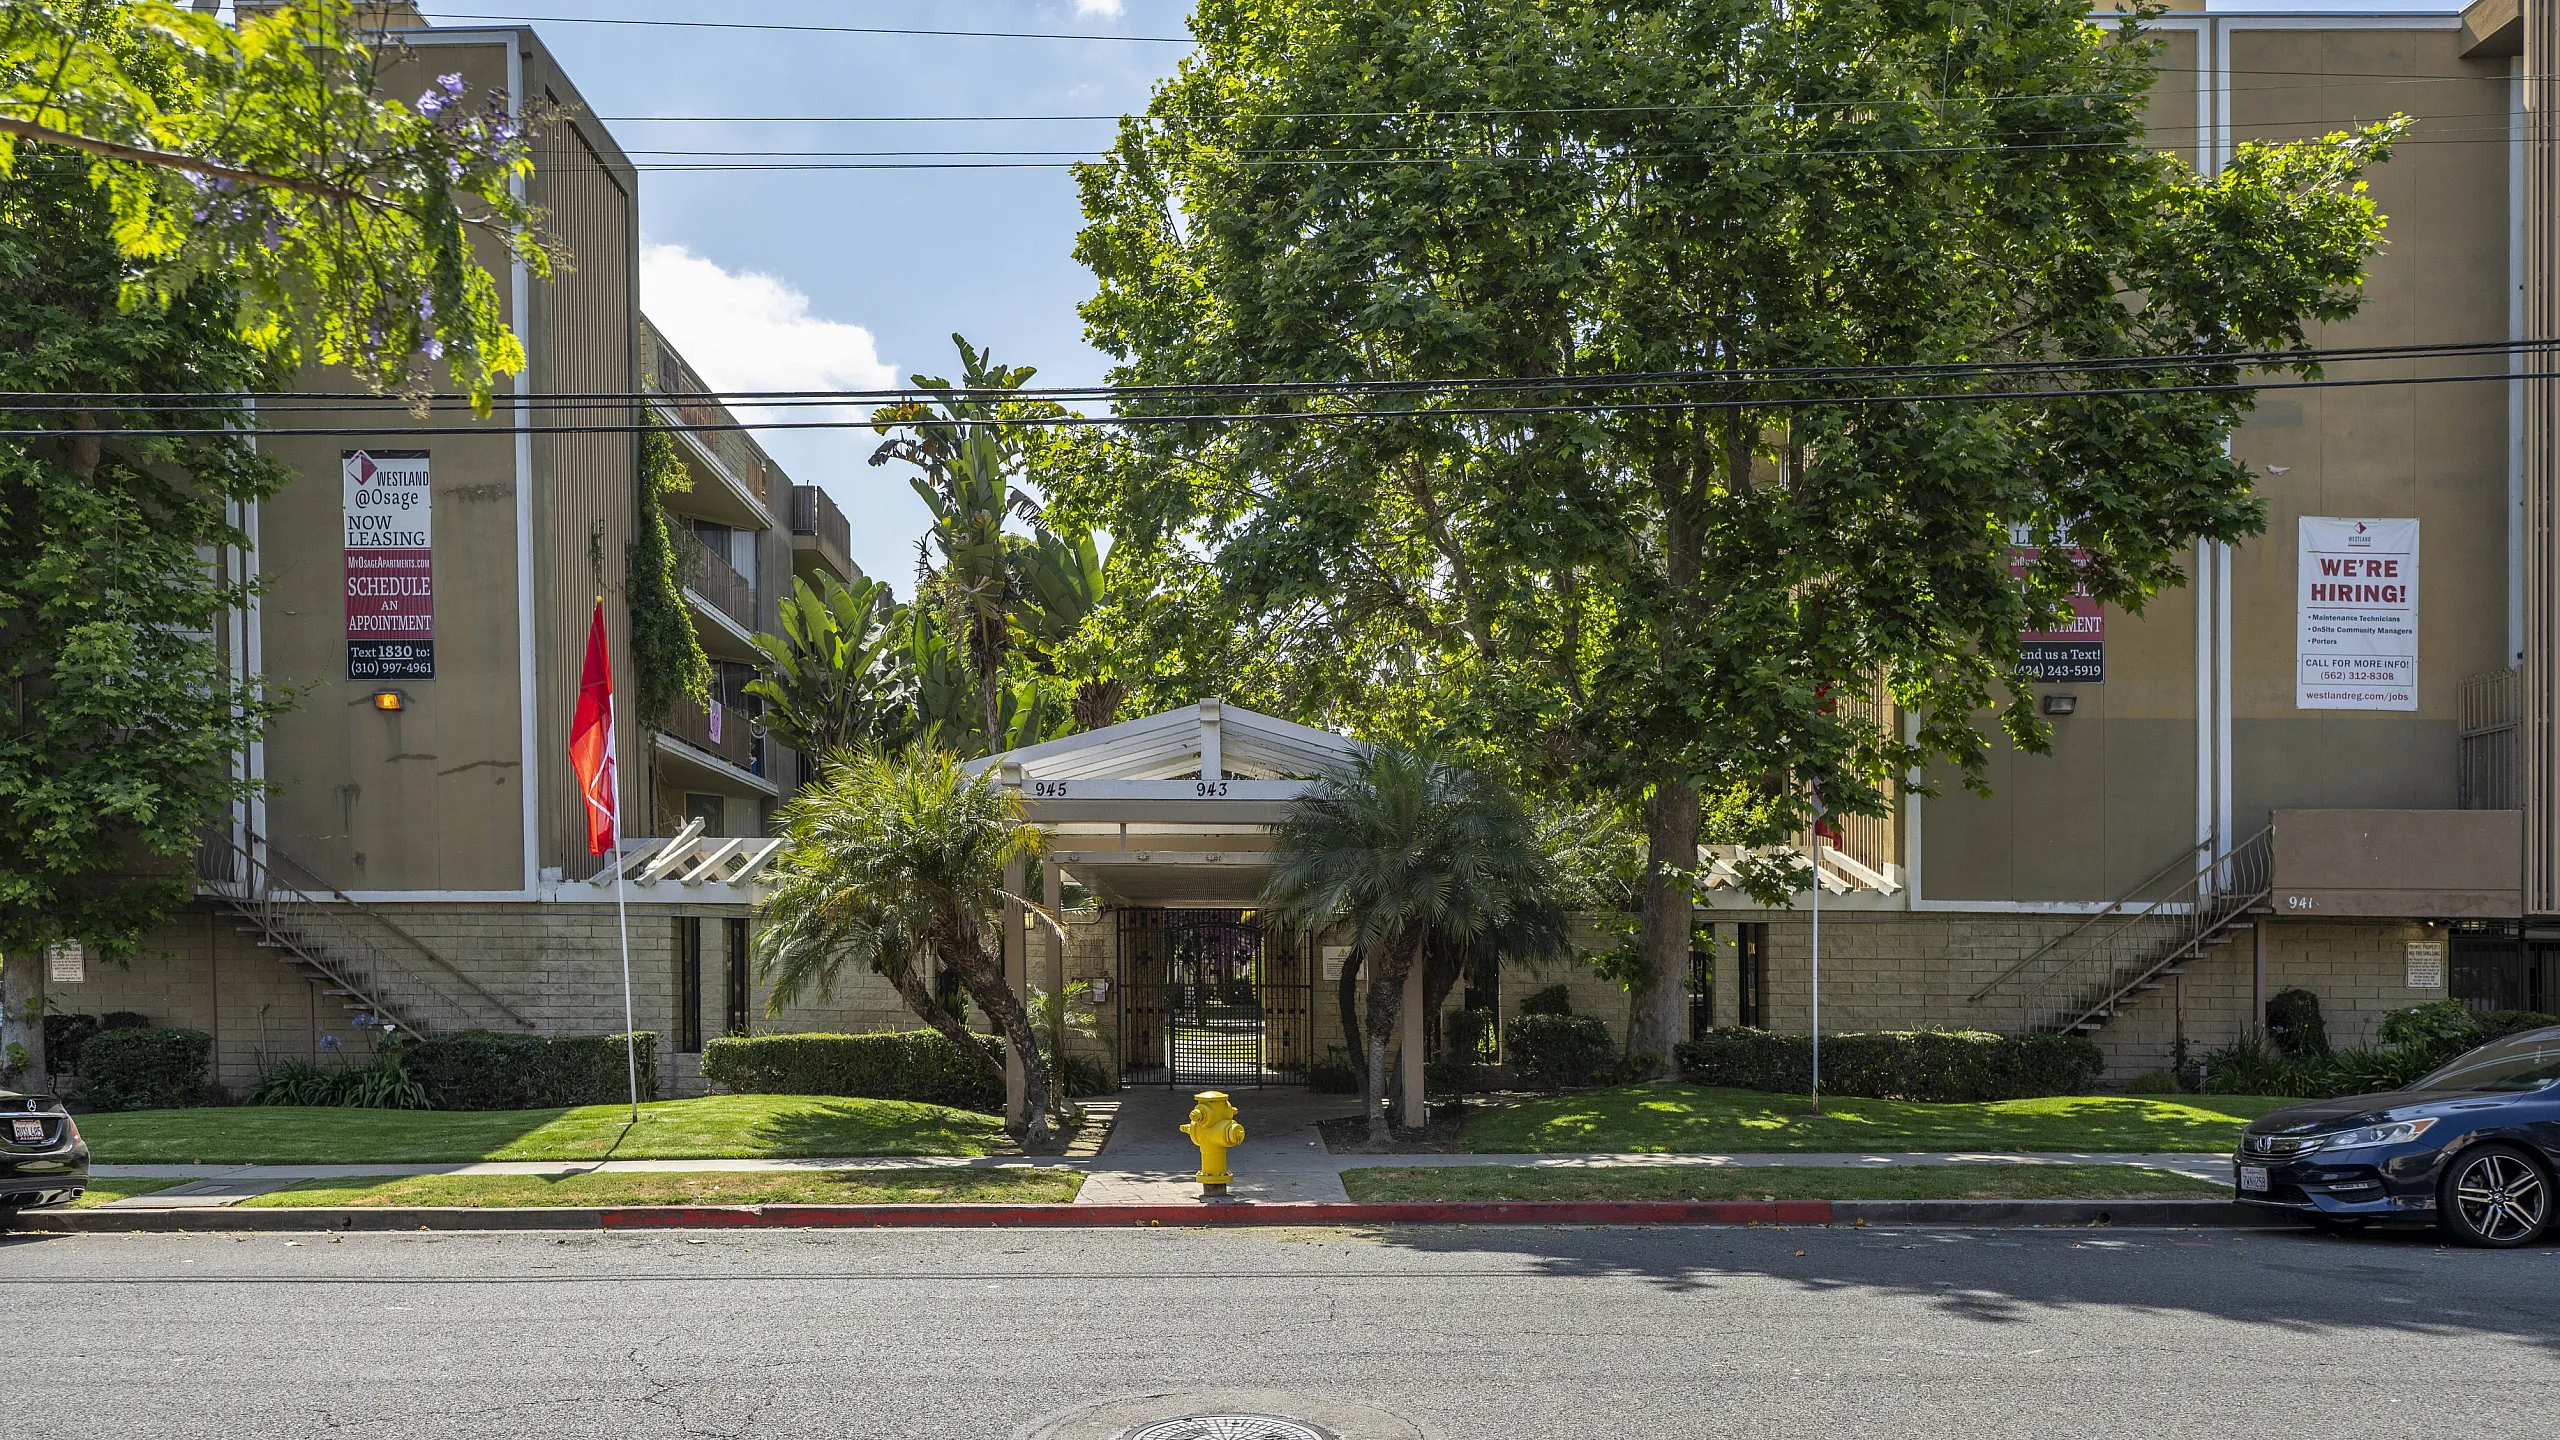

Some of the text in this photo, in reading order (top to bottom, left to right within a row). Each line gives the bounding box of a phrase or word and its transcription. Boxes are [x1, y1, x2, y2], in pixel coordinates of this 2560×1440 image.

[377, 471, 429, 487] WESTLAND
[355, 488, 419, 511] @Osage
[347, 515, 393, 531] NOW
[348, 531, 426, 547] LEASING
[348, 577, 431, 597] SCHEDULE
[2311, 583, 2406, 603] HIRING!
[380, 600, 399, 611] AN
[348, 615, 432, 631] APPOINTMENT
[2312, 614, 2401, 623] Maintenance Technicians
[2336, 626, 2376, 635] Community
[2377, 627, 2413, 636] Managers
[350, 645, 431, 658] Text 1830 to:
[2016, 648, 2101, 660] end us a Text!
[351, 660, 432, 676] (310) 997-4961
[2013, 662, 2101, 679] (424) 243-5919
[2305, 659, 2410, 669] CALL FOR MORE INFO!
[2320, 671, 2395, 681] (562) 312-8308
[2306, 691, 2409, 702] westlandreg.com/jobs
[1035, 782, 1067, 797] 945
[1196, 782, 1227, 797] 943
[2289, 896, 2313, 909] 941
